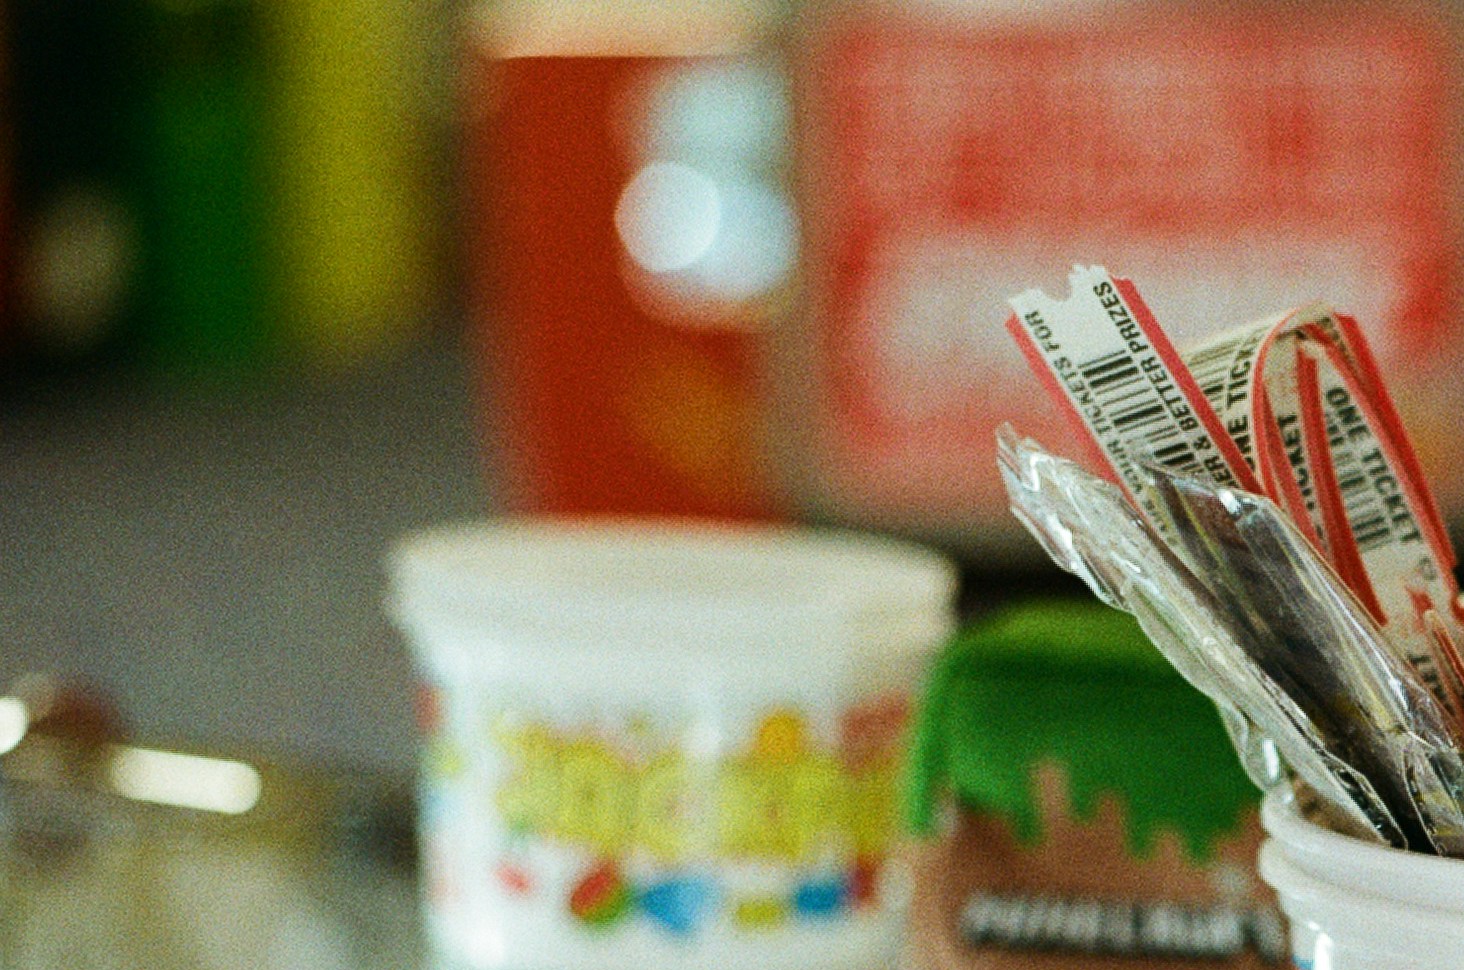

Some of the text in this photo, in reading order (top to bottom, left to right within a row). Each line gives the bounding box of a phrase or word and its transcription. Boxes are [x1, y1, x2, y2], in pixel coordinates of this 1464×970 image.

[1025, 310, 1061, 353] FOR
[1092, 281, 1150, 354] PRIZES
[1139, 356, 1199, 432] BETTER
